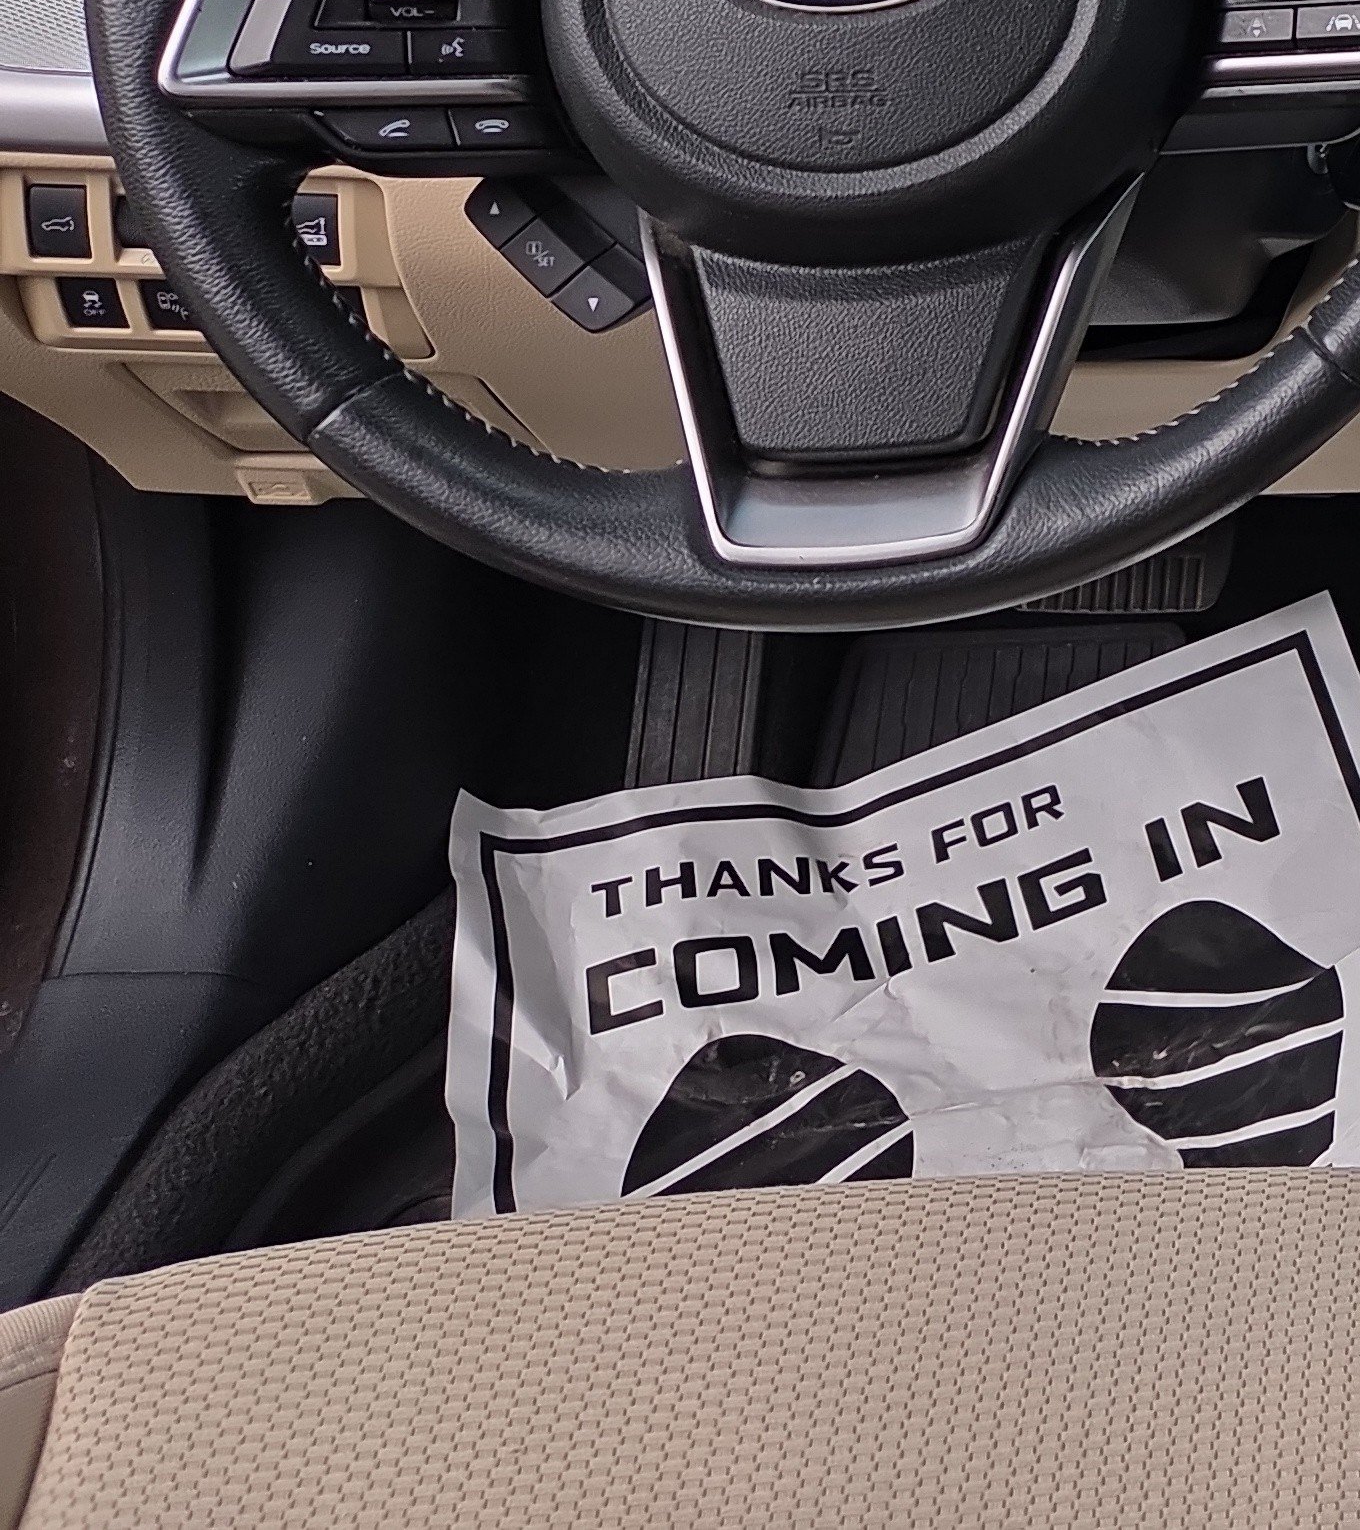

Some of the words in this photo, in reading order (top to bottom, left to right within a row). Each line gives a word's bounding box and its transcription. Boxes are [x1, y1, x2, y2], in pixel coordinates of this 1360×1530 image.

[309, 43, 371, 55] Source
[586, 846, 1109, 1037] COMING
[1143, 774, 1282, 885] IN
[591, 843, 906, 920] THANKS
[932, 784, 1066, 864] FOR
